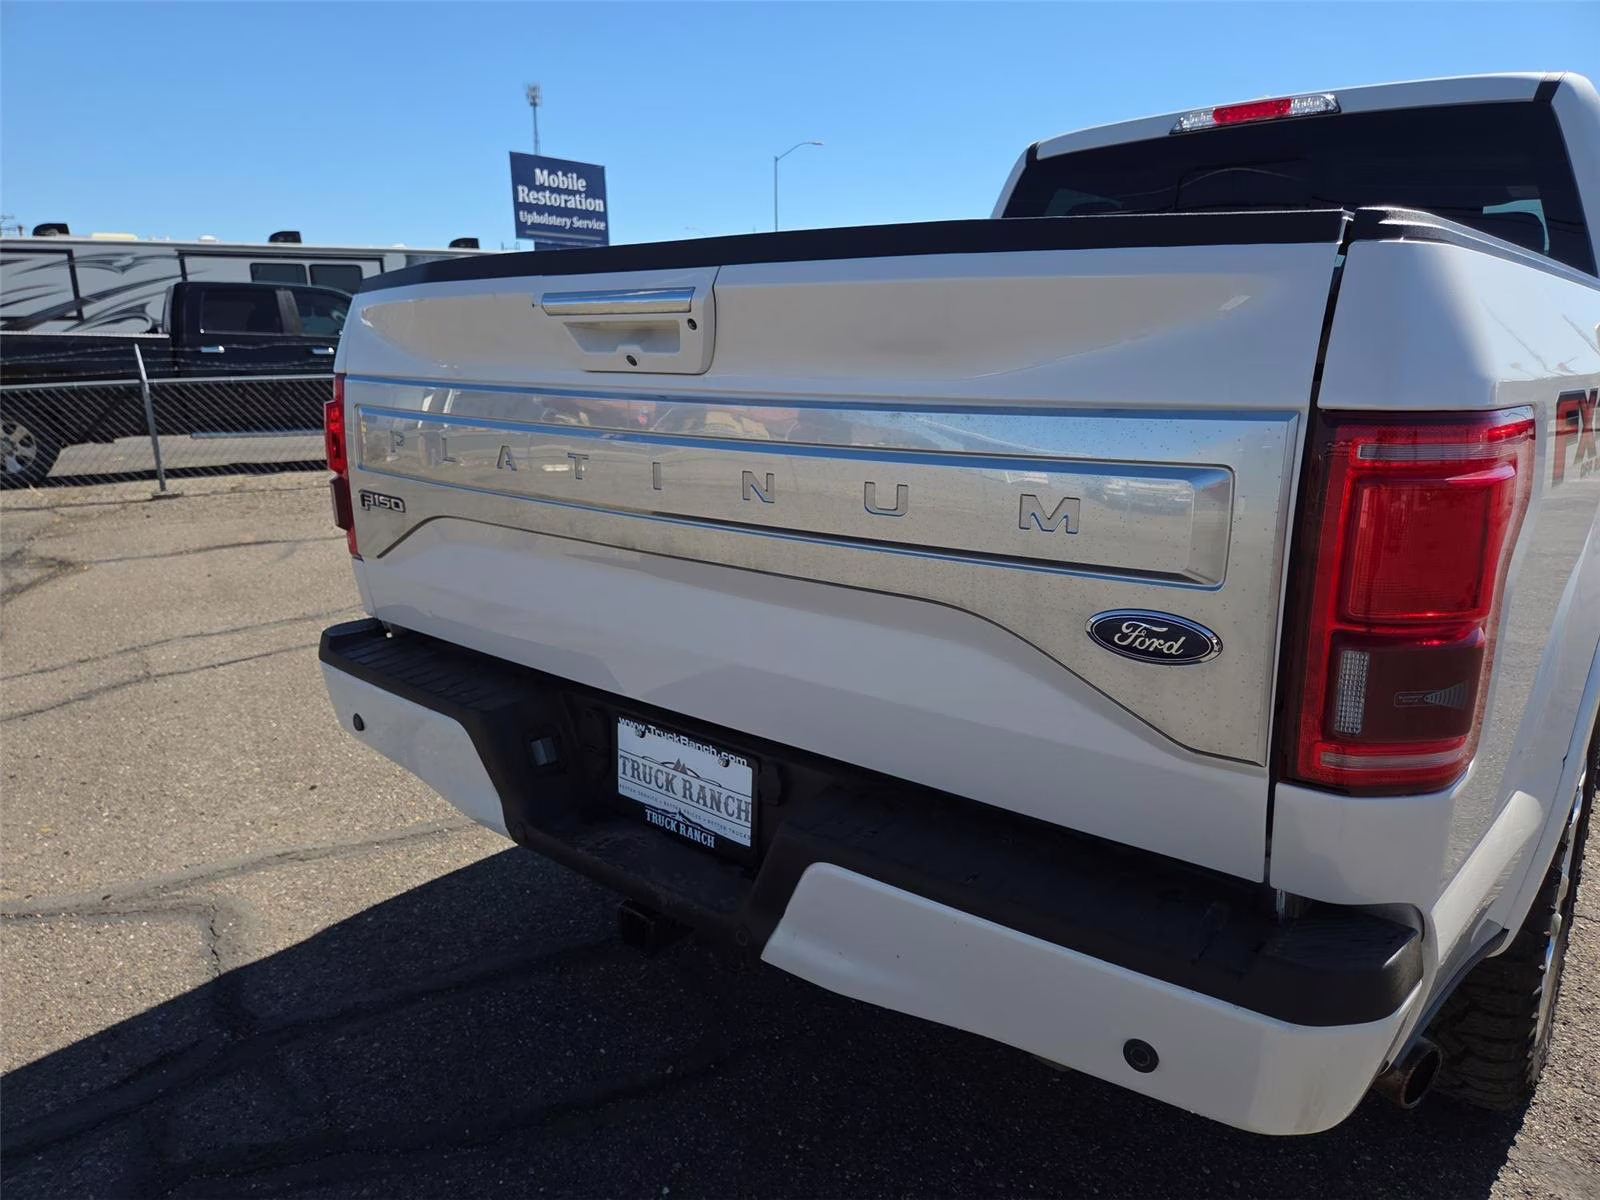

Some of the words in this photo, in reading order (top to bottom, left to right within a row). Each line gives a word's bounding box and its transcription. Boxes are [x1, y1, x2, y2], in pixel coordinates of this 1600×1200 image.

[517, 184, 605, 212] Restoration
[534, 167, 587, 192] Mobile
[519, 210, 572, 230] Upholstery
[572, 215, 606, 231] Service
[1551, 386, 1600, 488] FX
[390, 430, 1081, 535] PLATINUM
[1113, 620, 1186, 656] Ford
[619, 755, 678, 795] TRUCK
[681, 777, 751, 824] RANCH
[645, 808, 678, 833] TRUCK
[679, 822, 715, 849] RANCH
